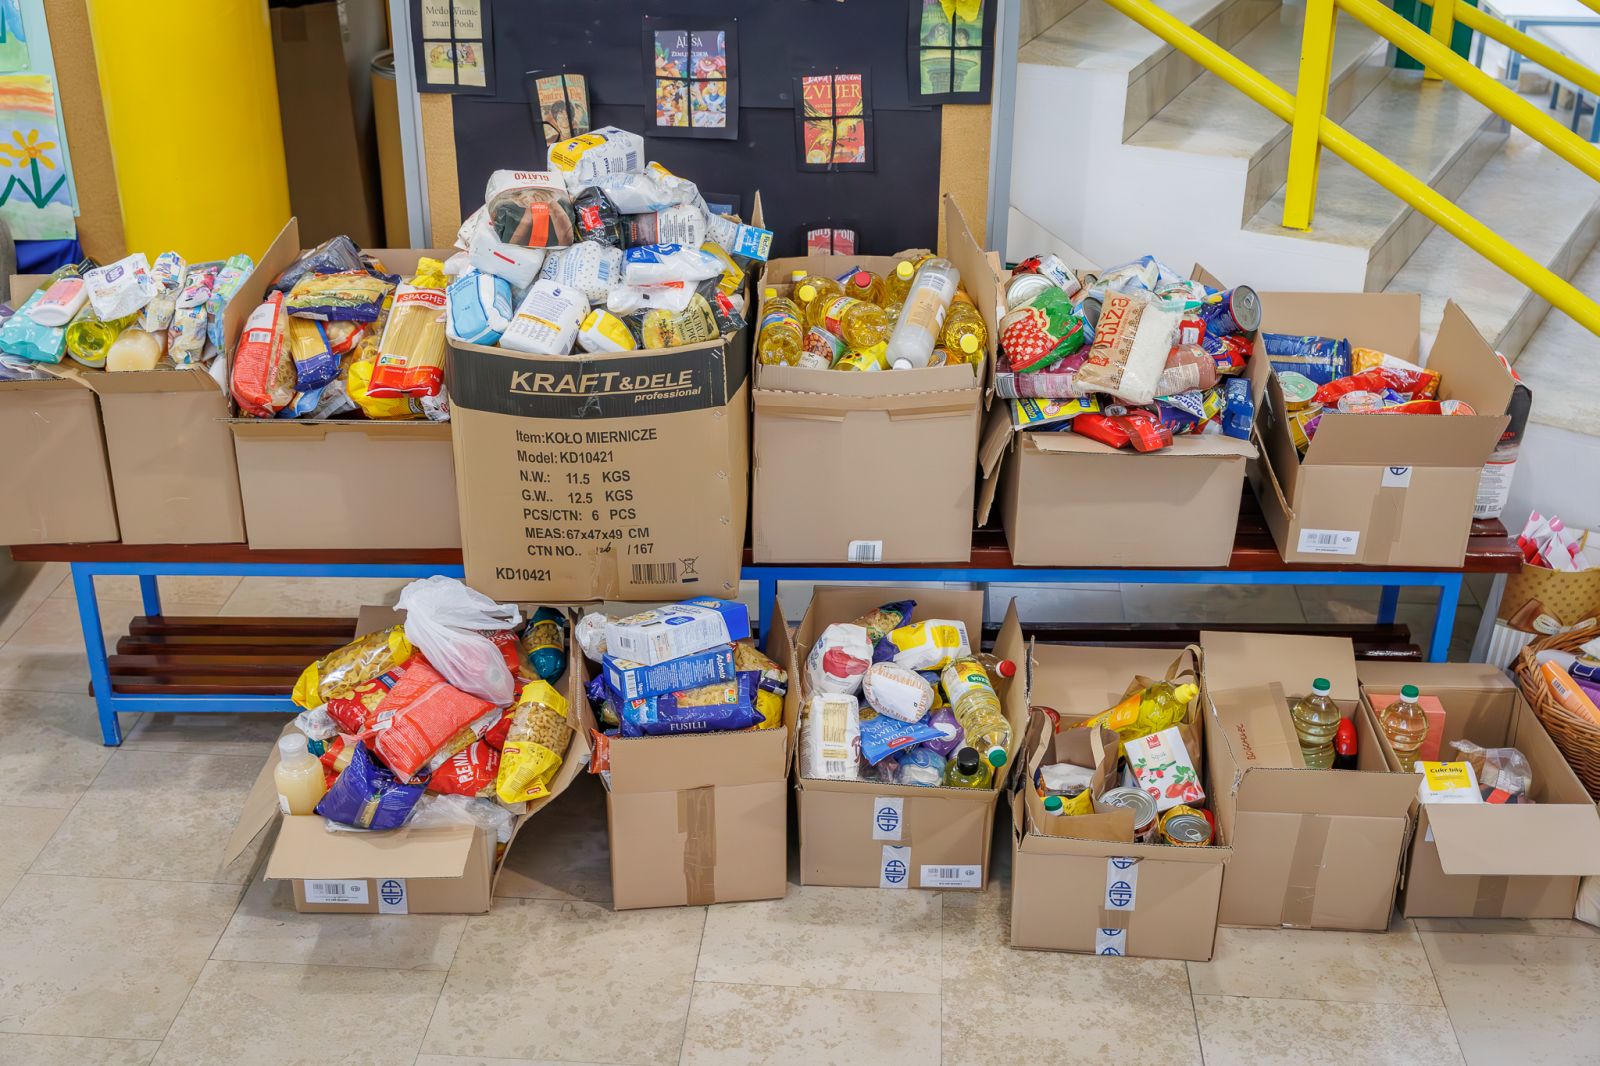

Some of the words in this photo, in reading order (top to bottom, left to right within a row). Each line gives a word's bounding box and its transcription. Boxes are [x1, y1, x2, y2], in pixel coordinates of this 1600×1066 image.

[425, 6, 448, 15] Medo
[431, 20, 449, 28] zvan
[454, 19, 474, 29] Pooh
[676, 35, 703, 48] ALSA
[803, 84, 862, 99] ZVIJER
[514, 172, 549, 181] GLATKO
[634, 386, 702, 403] professional
[585, 428, 657, 444] MIERNICZE
[560, 451, 614, 464] KD10421
[566, 473, 590, 485] 11.5
[602, 470, 631, 482] KGS
[568, 492, 593, 504] 12.5
[605, 489, 633, 502] KGS
[523, 508, 583, 521] PCS/CTN:
[592, 510, 599, 521] 6
[610, 508, 636, 520] PCS
[628, 527, 650, 539] CM
[527, 545, 553, 556] CTN
[495, 567, 551, 581] KD10421
[670, 720, 708, 731] FUSILLI
